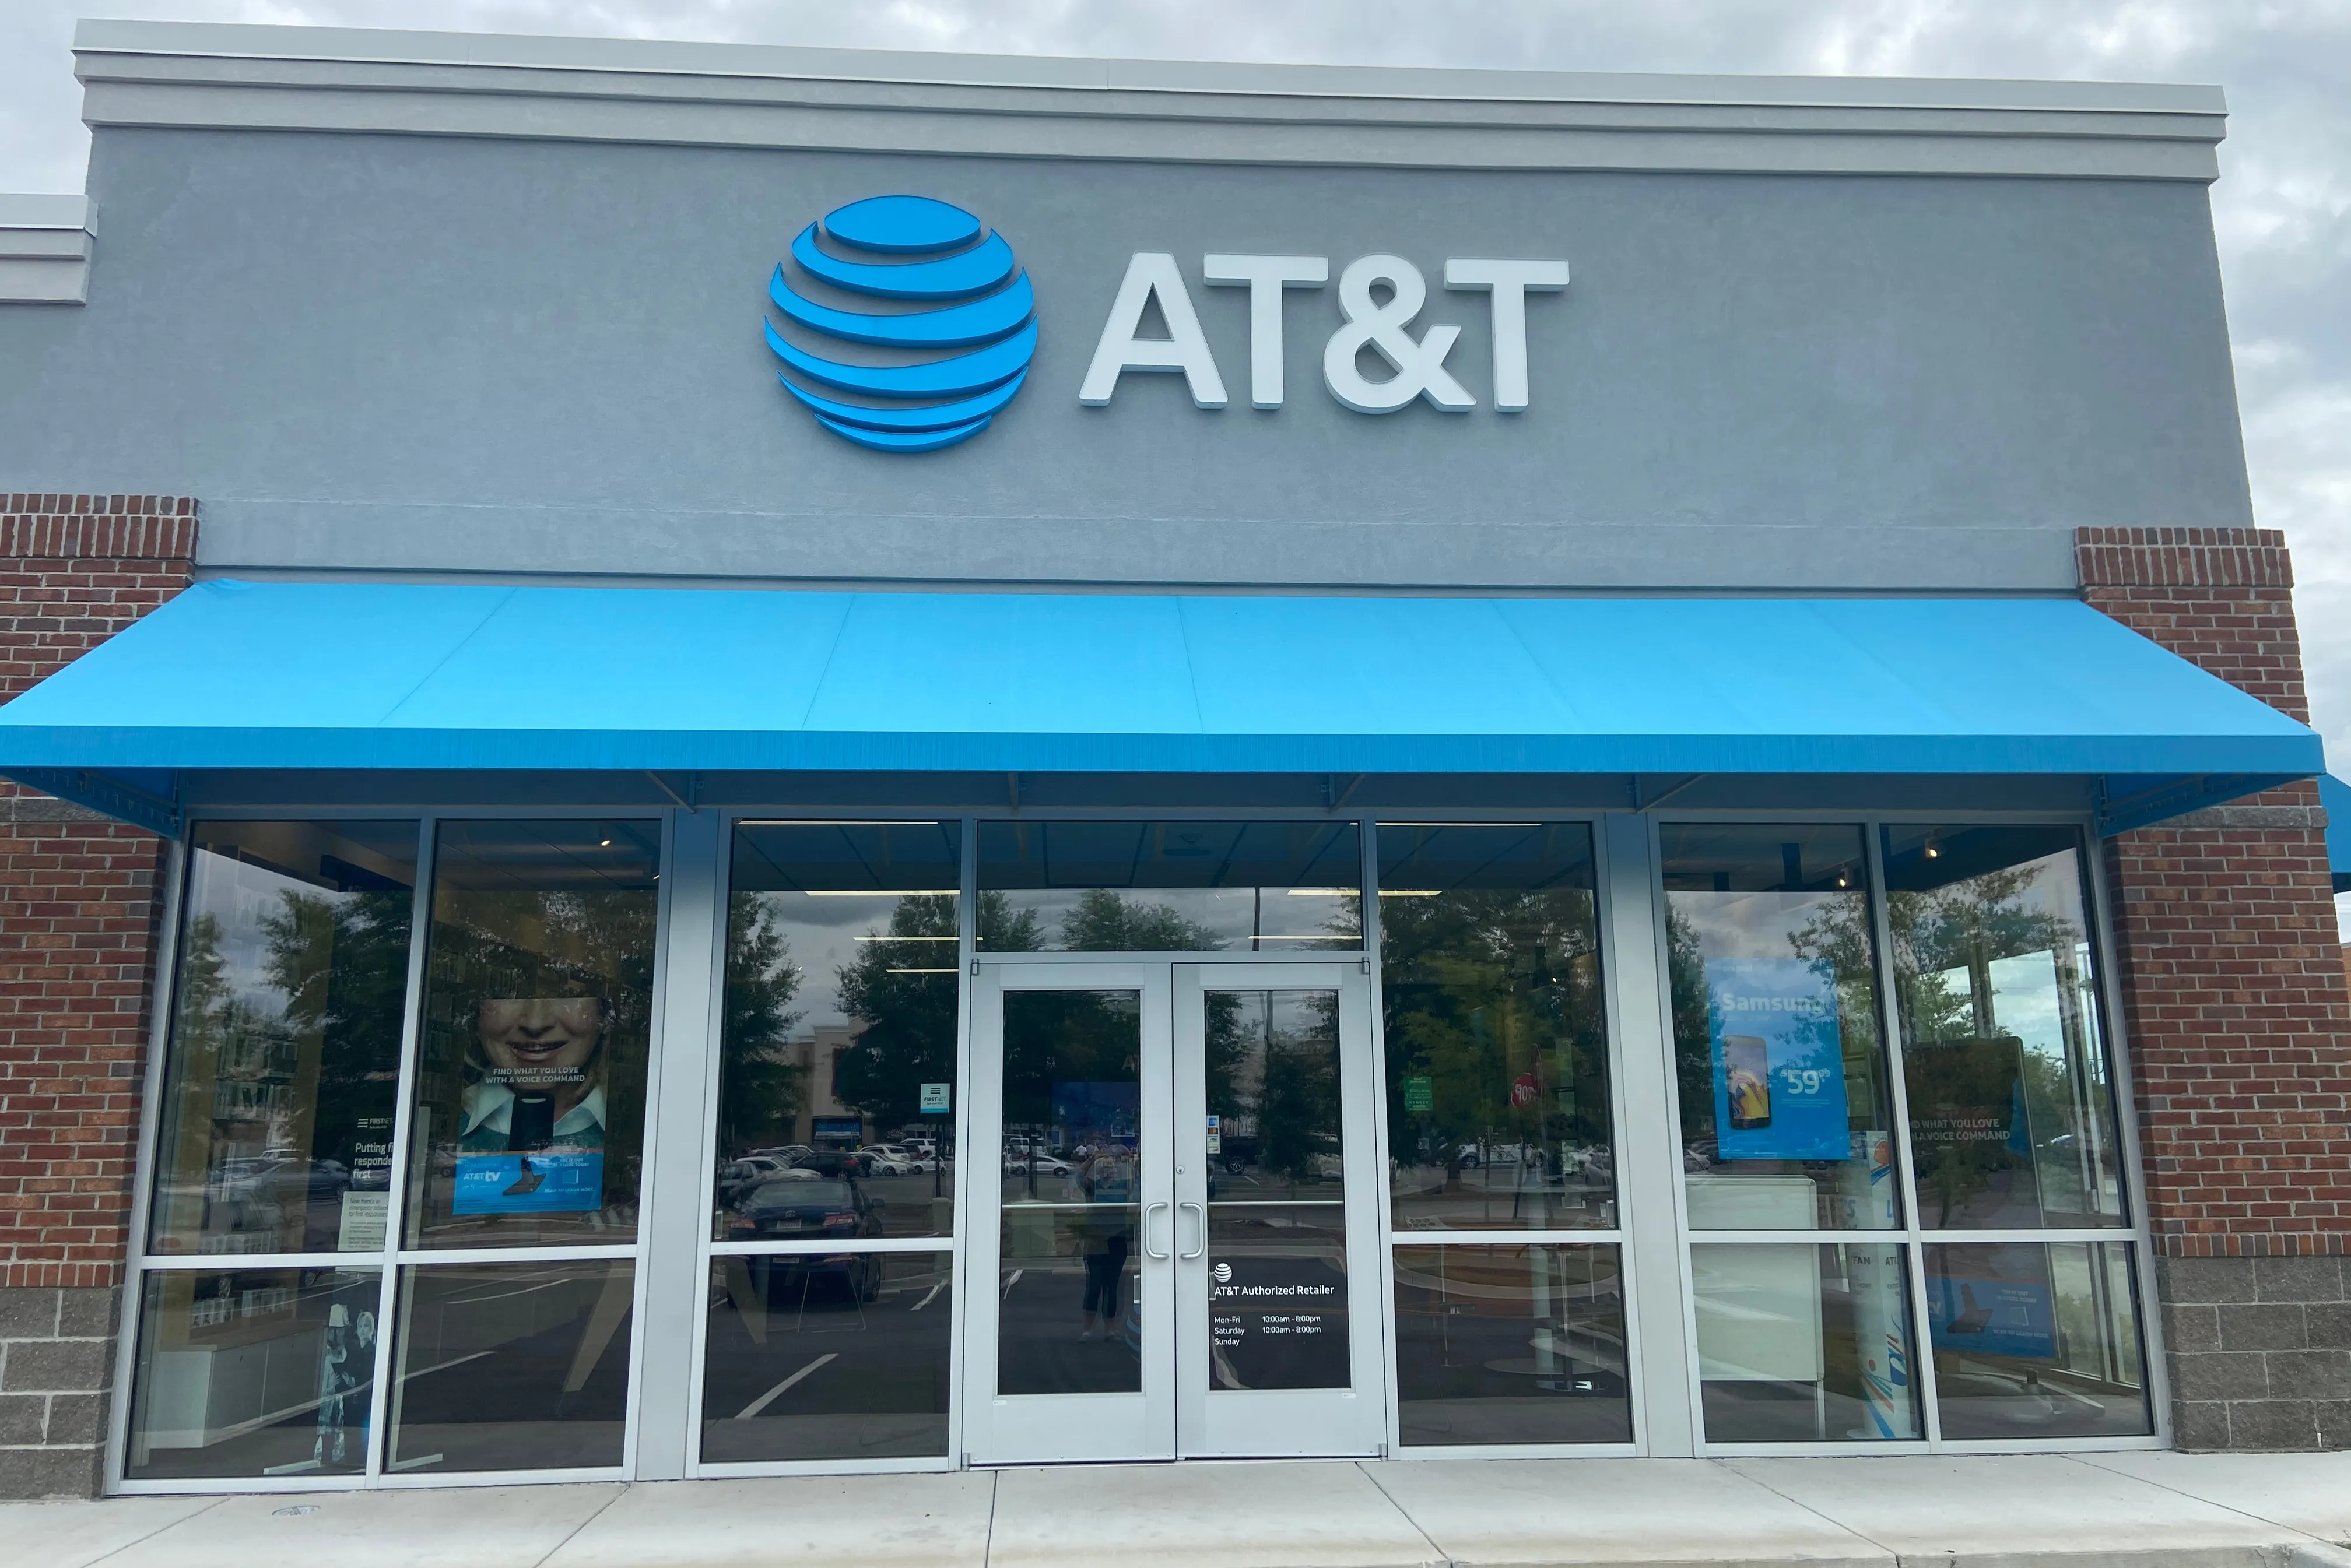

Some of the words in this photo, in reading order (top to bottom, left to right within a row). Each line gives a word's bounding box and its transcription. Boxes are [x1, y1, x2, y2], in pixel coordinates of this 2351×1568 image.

[1079, 250, 1570, 414] AT&T
[1722, 993, 1824, 1015] Samsung
[1921, 1119, 1948, 1128] WHAT
[1950, 1119, 1971, 1128] YOU
[1973, 1118, 2000, 1128] LOVE
[1927, 1131, 1955, 1141] VOICE
[1956, 1131, 2010, 1140] COMMAND
[356, 1142, 386, 1155] Putting
[354, 1155, 392, 1168] responde
[353, 1168, 371, 1179] first
[1215, 1286, 1240, 1296] AT&T
[1241, 1285, 1294, 1296] Authorized
[1297, 1285, 1335, 1295] Retailer
[1215, 1316, 1241, 1324] Mon-Fri
[1296, 1315, 1321, 1324] 8:00pm
[1215, 1327, 1245, 1335] Saturday
[1296, 1326, 1321, 1334] 8:00pm
[1215, 1338, 1240, 1346] Sunday
